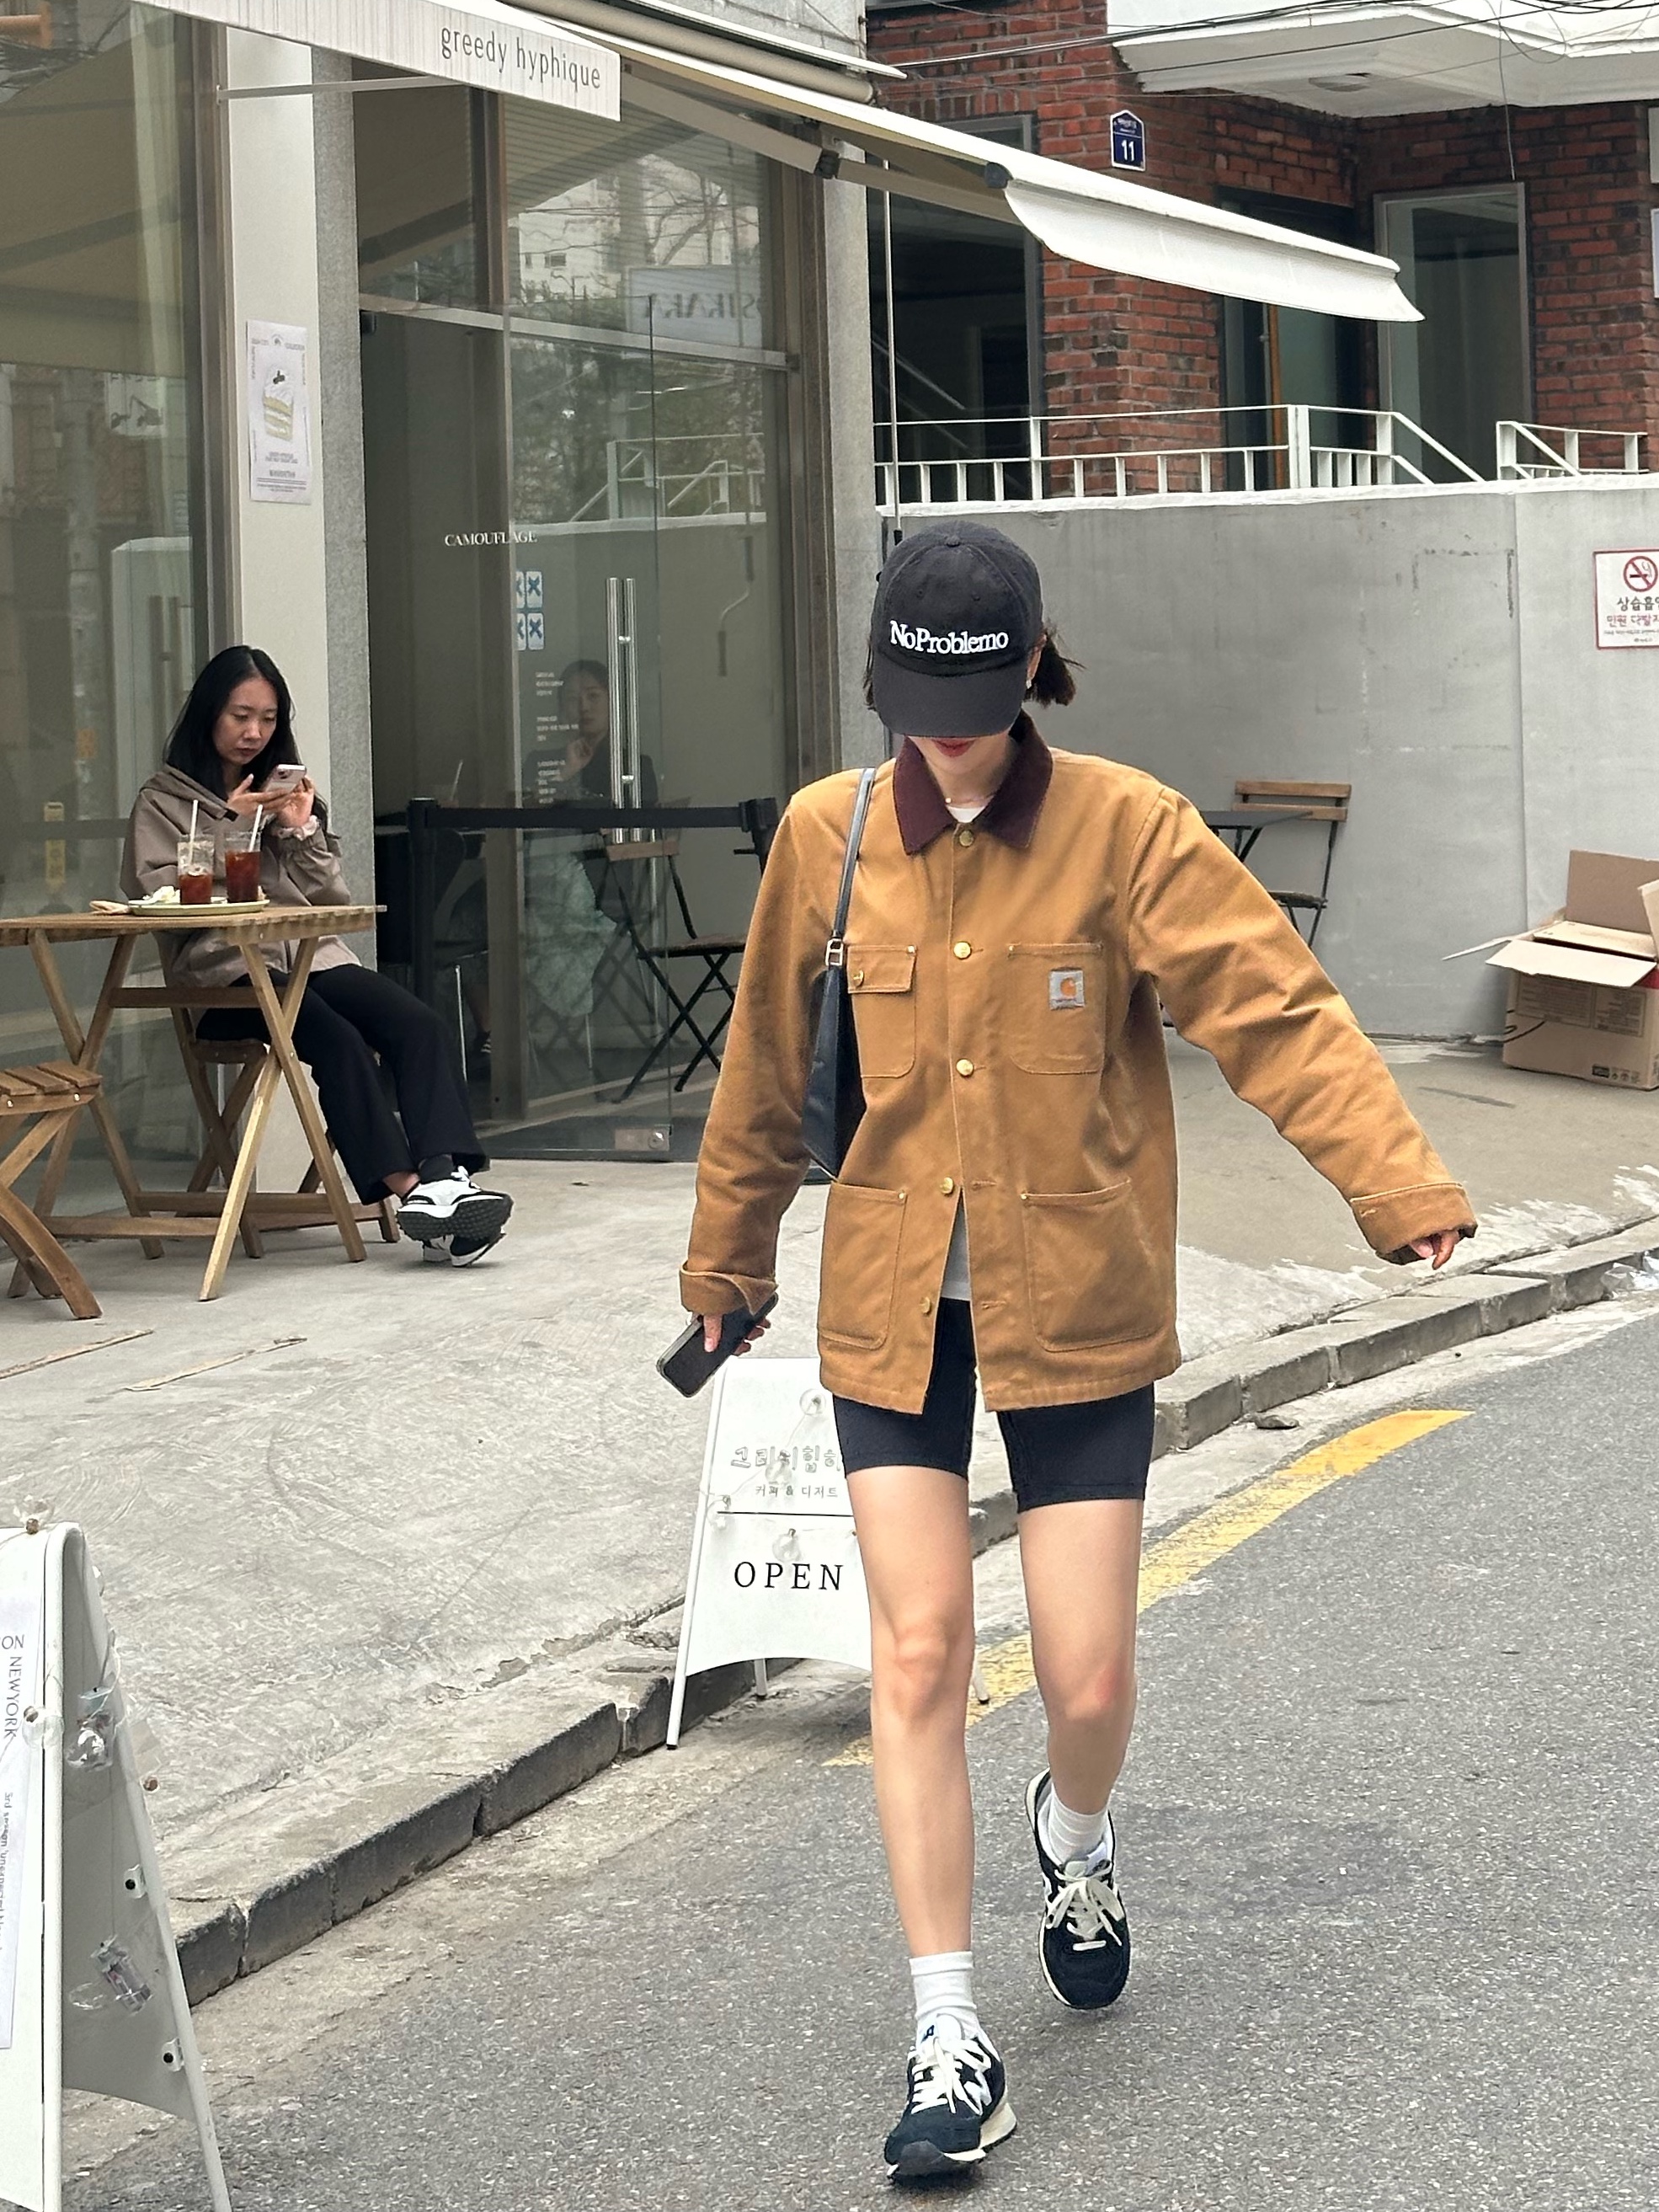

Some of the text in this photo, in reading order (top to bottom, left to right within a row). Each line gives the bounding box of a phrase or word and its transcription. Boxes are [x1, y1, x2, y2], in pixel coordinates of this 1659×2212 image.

[441, 27, 600, 93] greedy hyphique
[1121, 139, 1135, 162] 11
[444, 530, 538, 547] CAMOUFLAGE
[889, 619, 1010, 655] NoProblemo
[755, 1483, 839, 1499] 커피 & 디저트
[733, 1561, 844, 1591] OPEN
[0, 1633, 25, 1650] ON
[3, 1656, 24, 1739] NEWYORK
